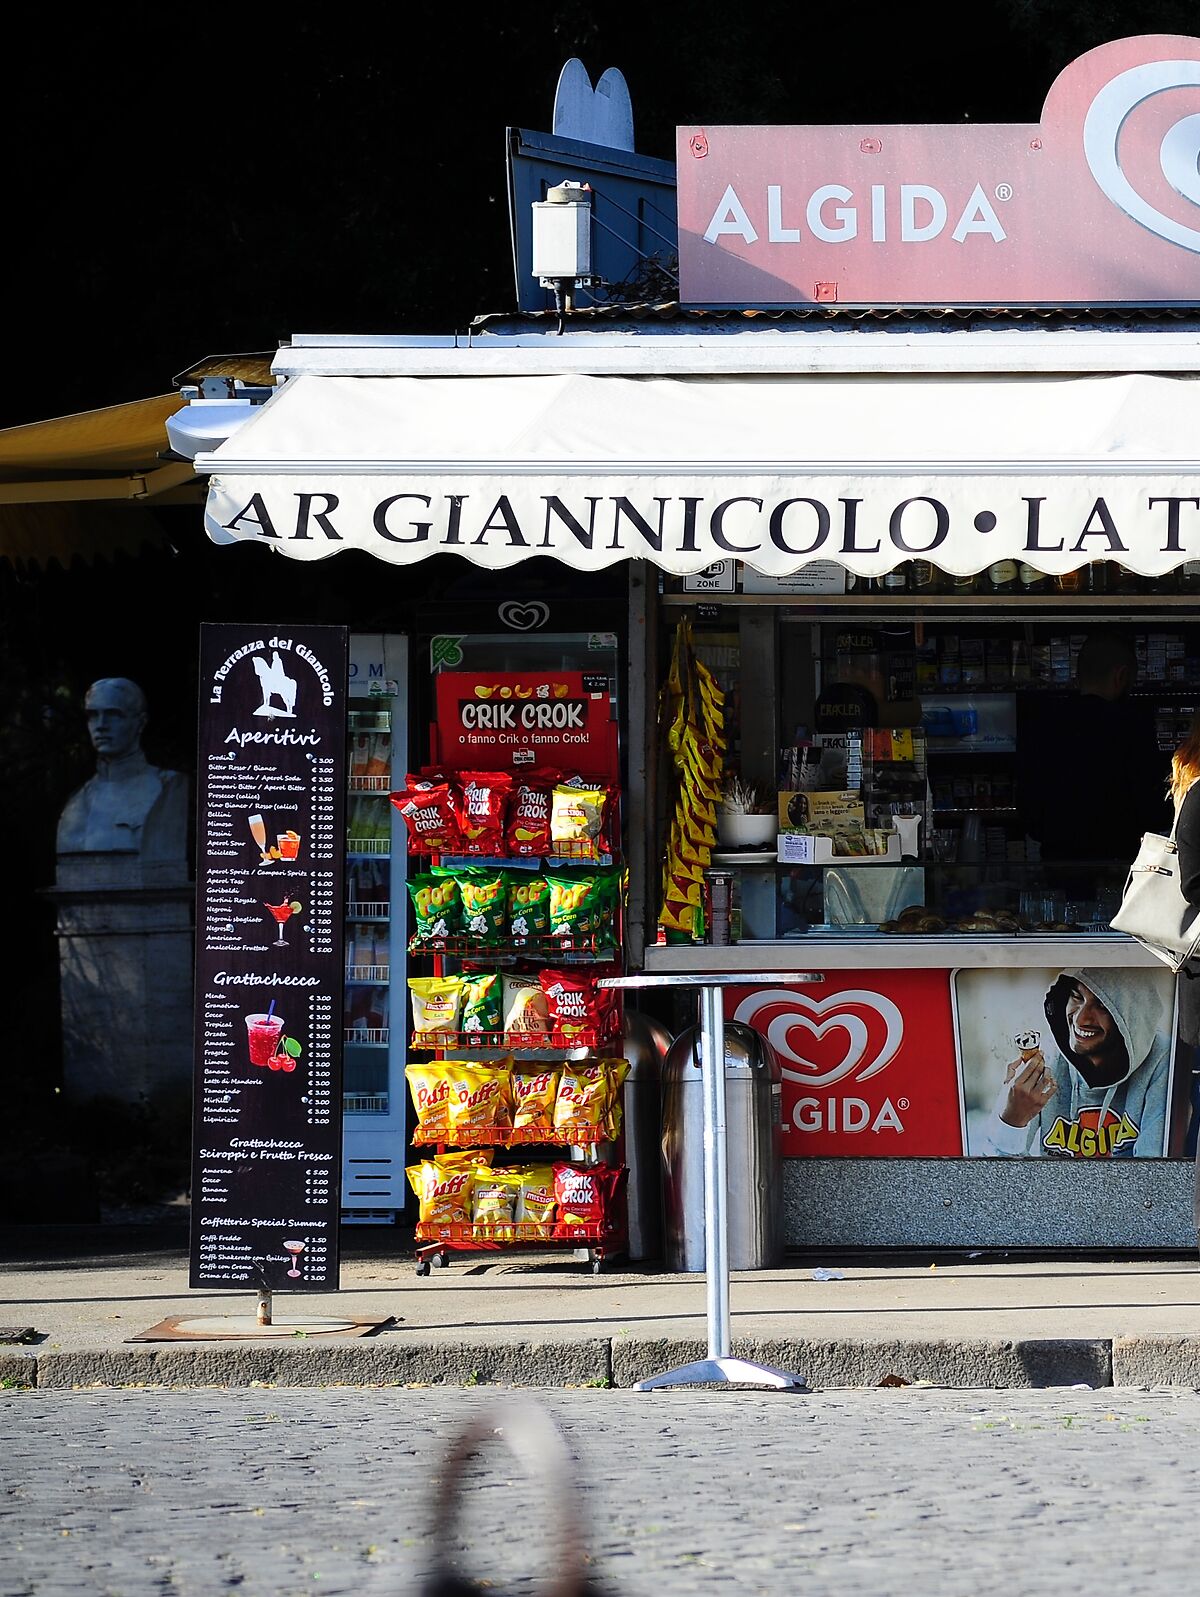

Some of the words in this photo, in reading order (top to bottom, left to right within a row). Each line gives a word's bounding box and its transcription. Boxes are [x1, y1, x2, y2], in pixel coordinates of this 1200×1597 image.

[373, 492, 950, 555] GIANNICOLO
[1021, 496, 1129, 553] LA
[696, 580, 720, 588] ZONE
[268, 637, 293, 651] del
[214, 640, 266, 681] Terrazza
[295, 644, 335, 706] Gianicolo
[210, 686, 222, 704] La
[462, 704, 517, 729] CRIK
[521, 703, 584, 729] CROK
[224, 727, 321, 748] Aperitivi
[459, 735, 465, 743] o
[468, 733, 496, 744] fanno
[498, 733, 520, 743] Crik
[522, 735, 529, 743] o
[531, 733, 560, 743] fanno
[562, 733, 590, 743] Crok!
[522, 792, 548, 806] CRIK
[413, 807, 440, 820] CRIK
[517, 805, 548, 819] CROK
[207, 906, 232, 914] Negroni
[213, 971, 320, 986] Grattachecca
[556, 992, 584, 1006] CRIK
[458, 1080, 499, 1109] Puff
[230, 1138, 304, 1148] Grattachecca
[200, 1148, 249, 1161] Sciroppi
[260, 1150, 296, 1160] Frutta
[298, 1151, 333, 1161] Fresca
[426, 1173, 469, 1200] Puff
[565, 1176, 592, 1190] CRIK
[561, 1190, 593, 1203] CROK
[200, 1217, 251, 1228] Caffetteria
[251, 1218, 287, 1228] Special
[288, 1219, 327, 1228] Summer
